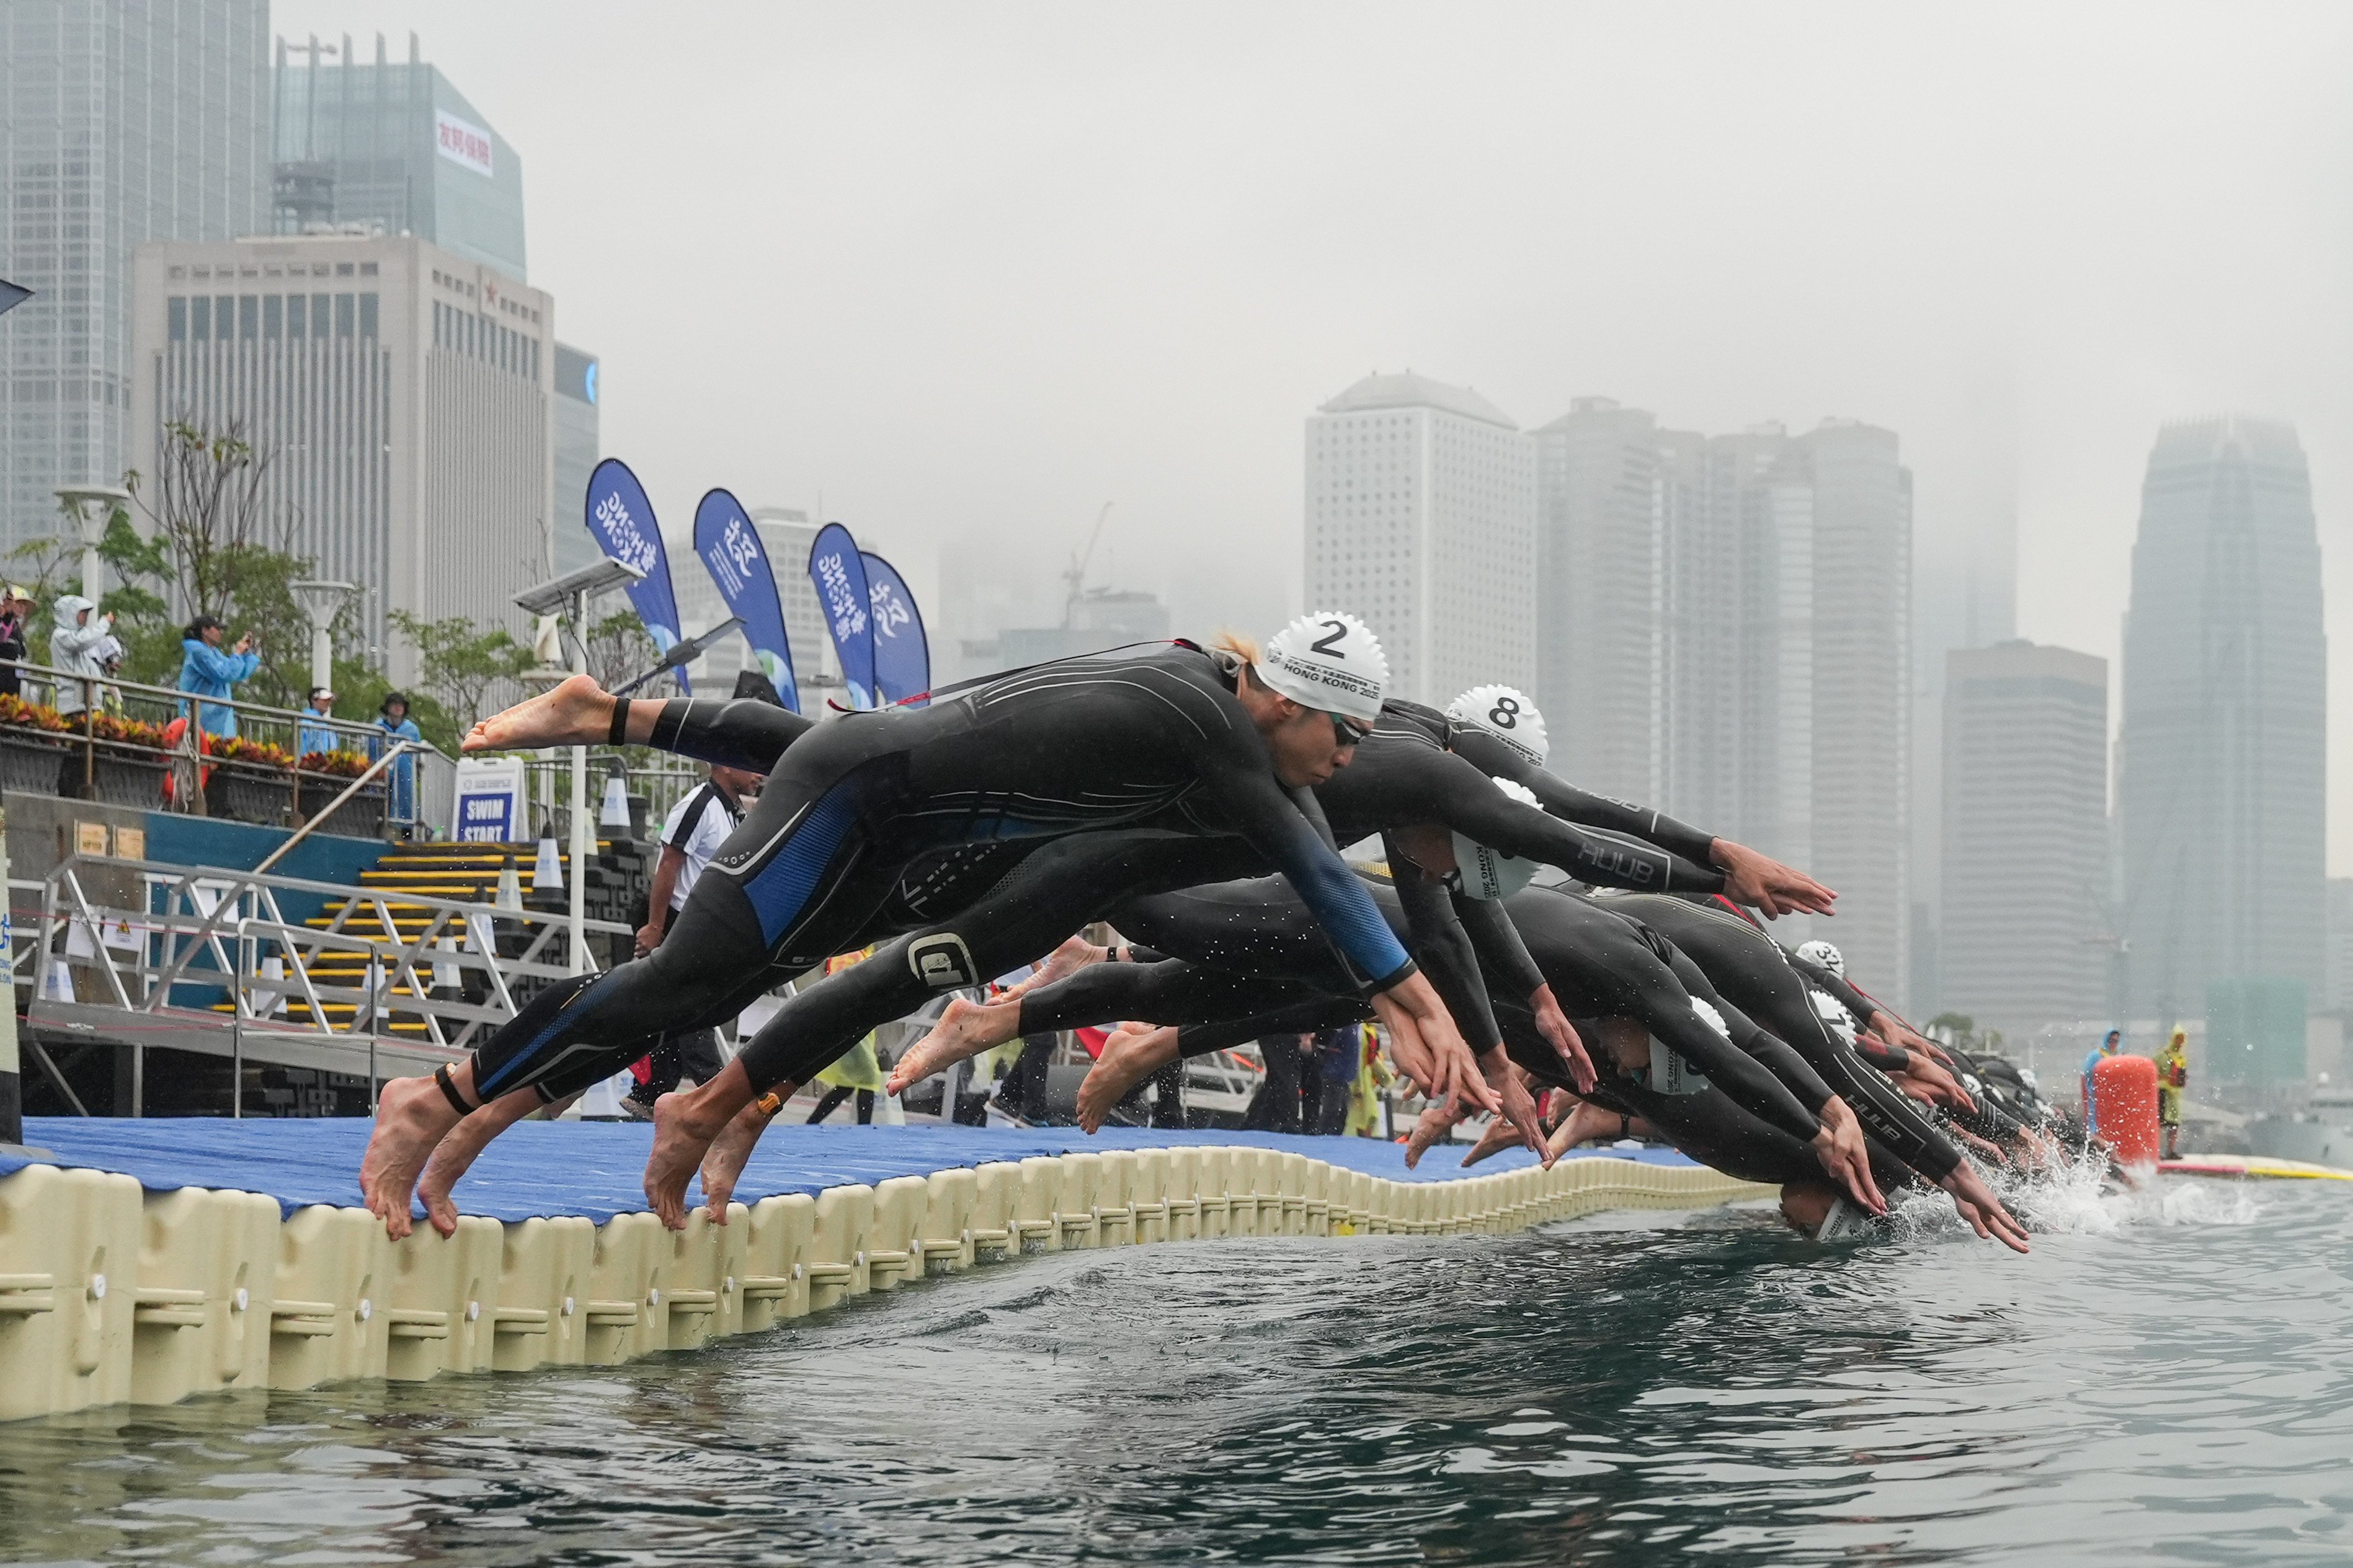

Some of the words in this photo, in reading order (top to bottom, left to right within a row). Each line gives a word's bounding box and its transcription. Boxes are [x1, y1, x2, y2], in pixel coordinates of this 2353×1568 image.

[1310, 620, 1347, 659] 2
[1284, 663, 1320, 681] HONG
[1322, 676, 1358, 693] KONG
[1359, 687, 1380, 700] 2025
[1489, 697, 1519, 729] 8
[466, 799, 504, 821] SWIM
[464, 825, 504, 843] START
[1476, 846, 1488, 879] KONG
[1577, 842, 1655, 884] HUUB
[1844, 1094, 1902, 1140] HUUB
